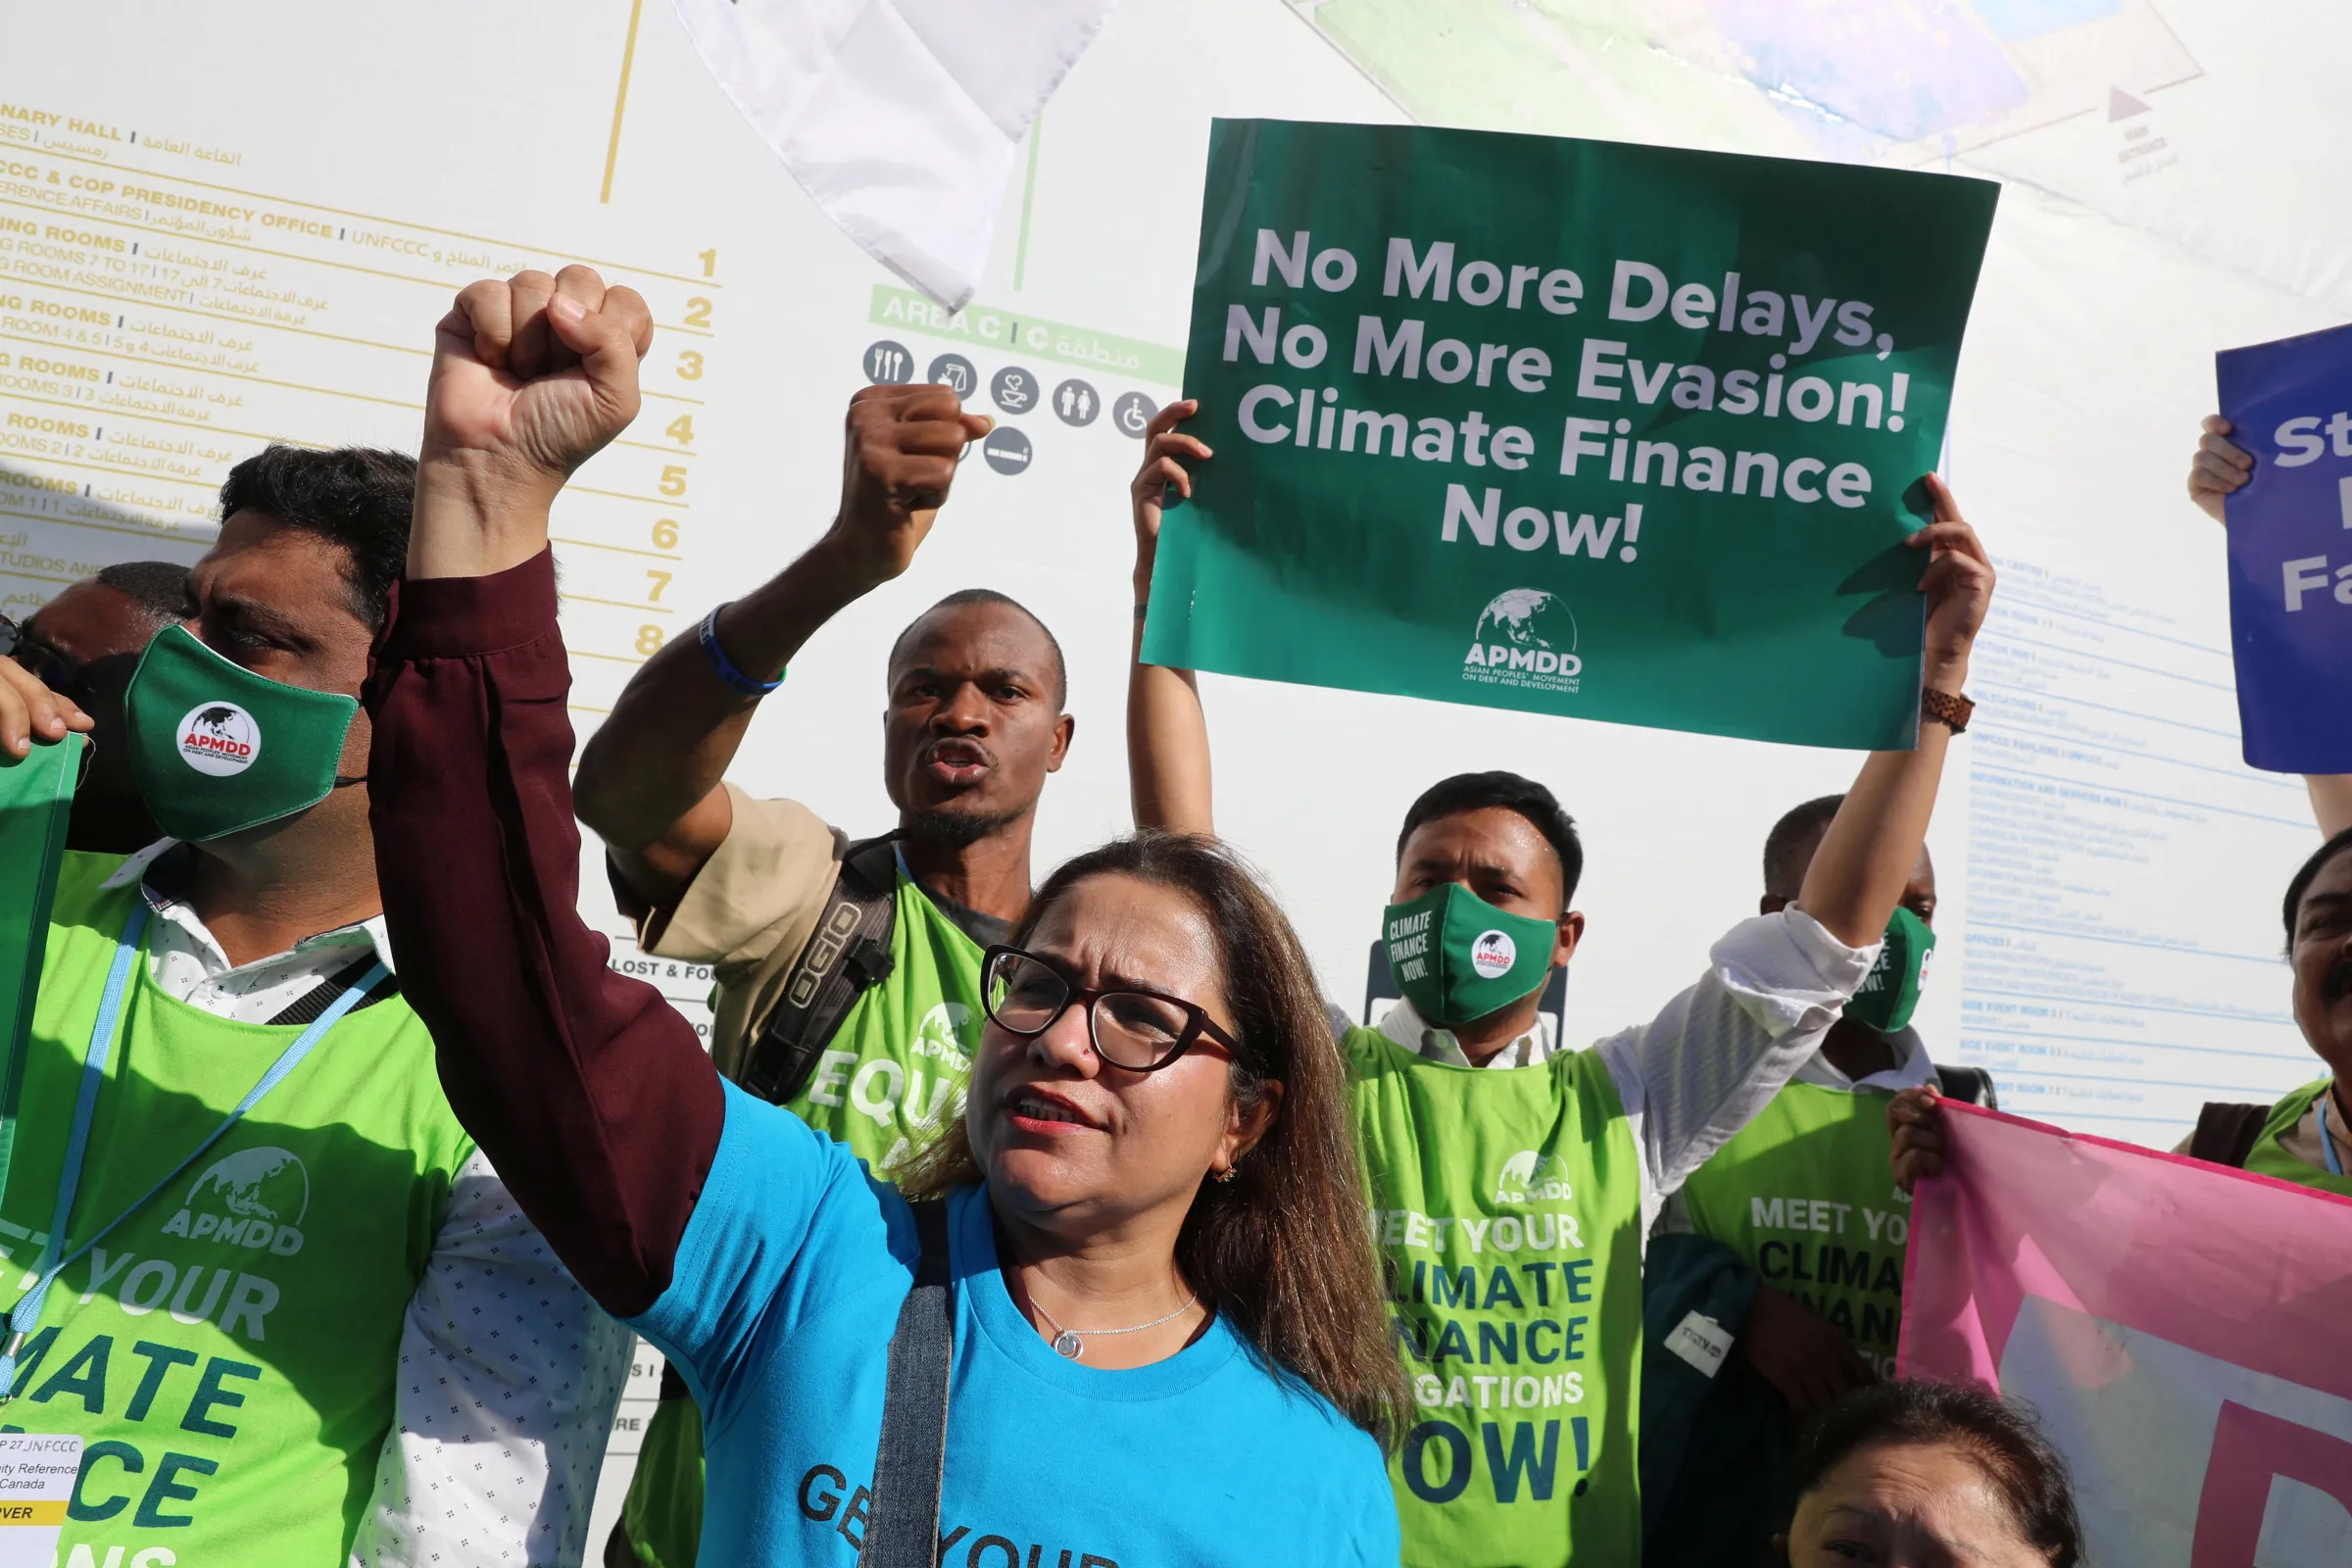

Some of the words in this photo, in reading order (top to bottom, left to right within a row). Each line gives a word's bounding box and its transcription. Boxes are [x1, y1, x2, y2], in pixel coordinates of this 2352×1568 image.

[68, 117, 122, 141] HALL
[142, 135, 190, 155] العامة
[194, 145, 242, 166] القاعة
[47, 170, 61, 186] &
[69, 173, 115, 194] COP
[121, 183, 257, 222] PRESIDENCY
[261, 212, 334, 239] OFFICE
[70, 195, 142, 220] AFFAIRS
[45, 225, 126, 253] ROOMS
[352, 228, 429, 257] UNFCCC
[18, 240, 85, 266] ROOMS
[89, 254, 99, 267] 7
[104, 256, 126, 272] TO
[130, 262, 150, 276] 17
[144, 246, 228, 272] الاجتماعات
[698, 248, 717, 276] 1
[14, 259, 70, 281] ROOM
[72, 270, 187, 303] ASSIGNMENT
[162, 268, 180, 283] 17
[212, 277, 223, 290] 7
[231, 265, 268, 281] غرف
[223, 281, 297, 305] الاجتماعات
[297, 294, 329, 312] غرف
[1251, 228, 1357, 292] No
[1383, 236, 1584, 316] More
[1608, 259, 1894, 362] Delays,
[30, 299, 111, 325] ROOMS
[199, 295, 272, 318] الاجتماعات
[683, 297, 713, 328] 2
[1, 316, 59, 338] ROOM
[63, 327, 73, 340] 4
[76, 329, 87, 343] &
[92, 331, 102, 345] 5
[130, 318, 215, 345] الاجتماعات
[978, 316, 1002, 339] C
[1026, 326, 1050, 350] C
[114, 335, 124, 349] 5
[139, 341, 149, 353] 4
[218, 336, 254, 353] غرف
[1055, 334, 1141, 371] منطقة
[150, 343, 226, 367] الاجتماعات
[676, 350, 705, 381] 3
[19, 356, 100, 383] ROOMS
[1222, 304, 1328, 368] No
[1352, 315, 1552, 393] More
[1577, 337, 1910, 433] Evasion!
[0, 373, 59, 395] OOMS
[63, 384, 73, 397] 3
[85, 388, 95, 401] 3
[119, 374, 204, 401] الاجتماعات
[99, 392, 175, 415] الاجتماعات
[208, 392, 243, 408] غرف
[8, 413, 89, 438] ROOMS
[665, 414, 695, 445] 4
[51, 441, 62, 455] 2
[73, 444, 84, 459] 2
[108, 431, 193, 457] الاجتماعات
[197, 447, 233, 464] غرف
[1237, 383, 1536, 471] Climate
[1559, 416, 1873, 509] Finance
[88, 449, 165, 471] الاجتماعات
[658, 465, 688, 497] 5
[29, 497, 36, 510] 1
[97, 490, 183, 513] الاجتماعات
[65, 504, 144, 526] الاجتماعات
[1441, 483, 1643, 564] Now!
[651, 518, 680, 550] 6
[646, 569, 672, 603] 7
[634, 624, 663, 658] 8
[1464, 642, 1583, 677] APMDD
[1462, 672, 1477, 681] ON
[1478, 674, 1498, 684] DEBT
[1499, 677, 1519, 687] AND
[1521, 679, 1580, 694] DEVELOPMENT
[1463, 665, 1490, 675] ASIAN
[1532, 673, 1581, 686] MOVEMENT
[184, 733, 251, 757] APMDD
[1390, 909, 1432, 941] CLIMATE
[788, 901, 862, 1009] OGIO
[1391, 932, 1429, 963] FINANCE
[1476, 952, 1511, 965] APMDD
[612, 959, 660, 976] LOST
[666, 964, 677, 978] &
[1401, 956, 1429, 983] NOW!
[1494, 1182, 1572, 1204] APMDD
[1750, 1197, 1851, 1234] MEET
[161, 1208, 304, 1256] APMDD
[1461, 1211, 1585, 1254] YOUR
[78, 1247, 280, 1343] YOUR
[9, 1440, 24, 1449] 27
[18, 1462, 78, 1475] Reference
[0, 1478, 45, 1490] Canada
